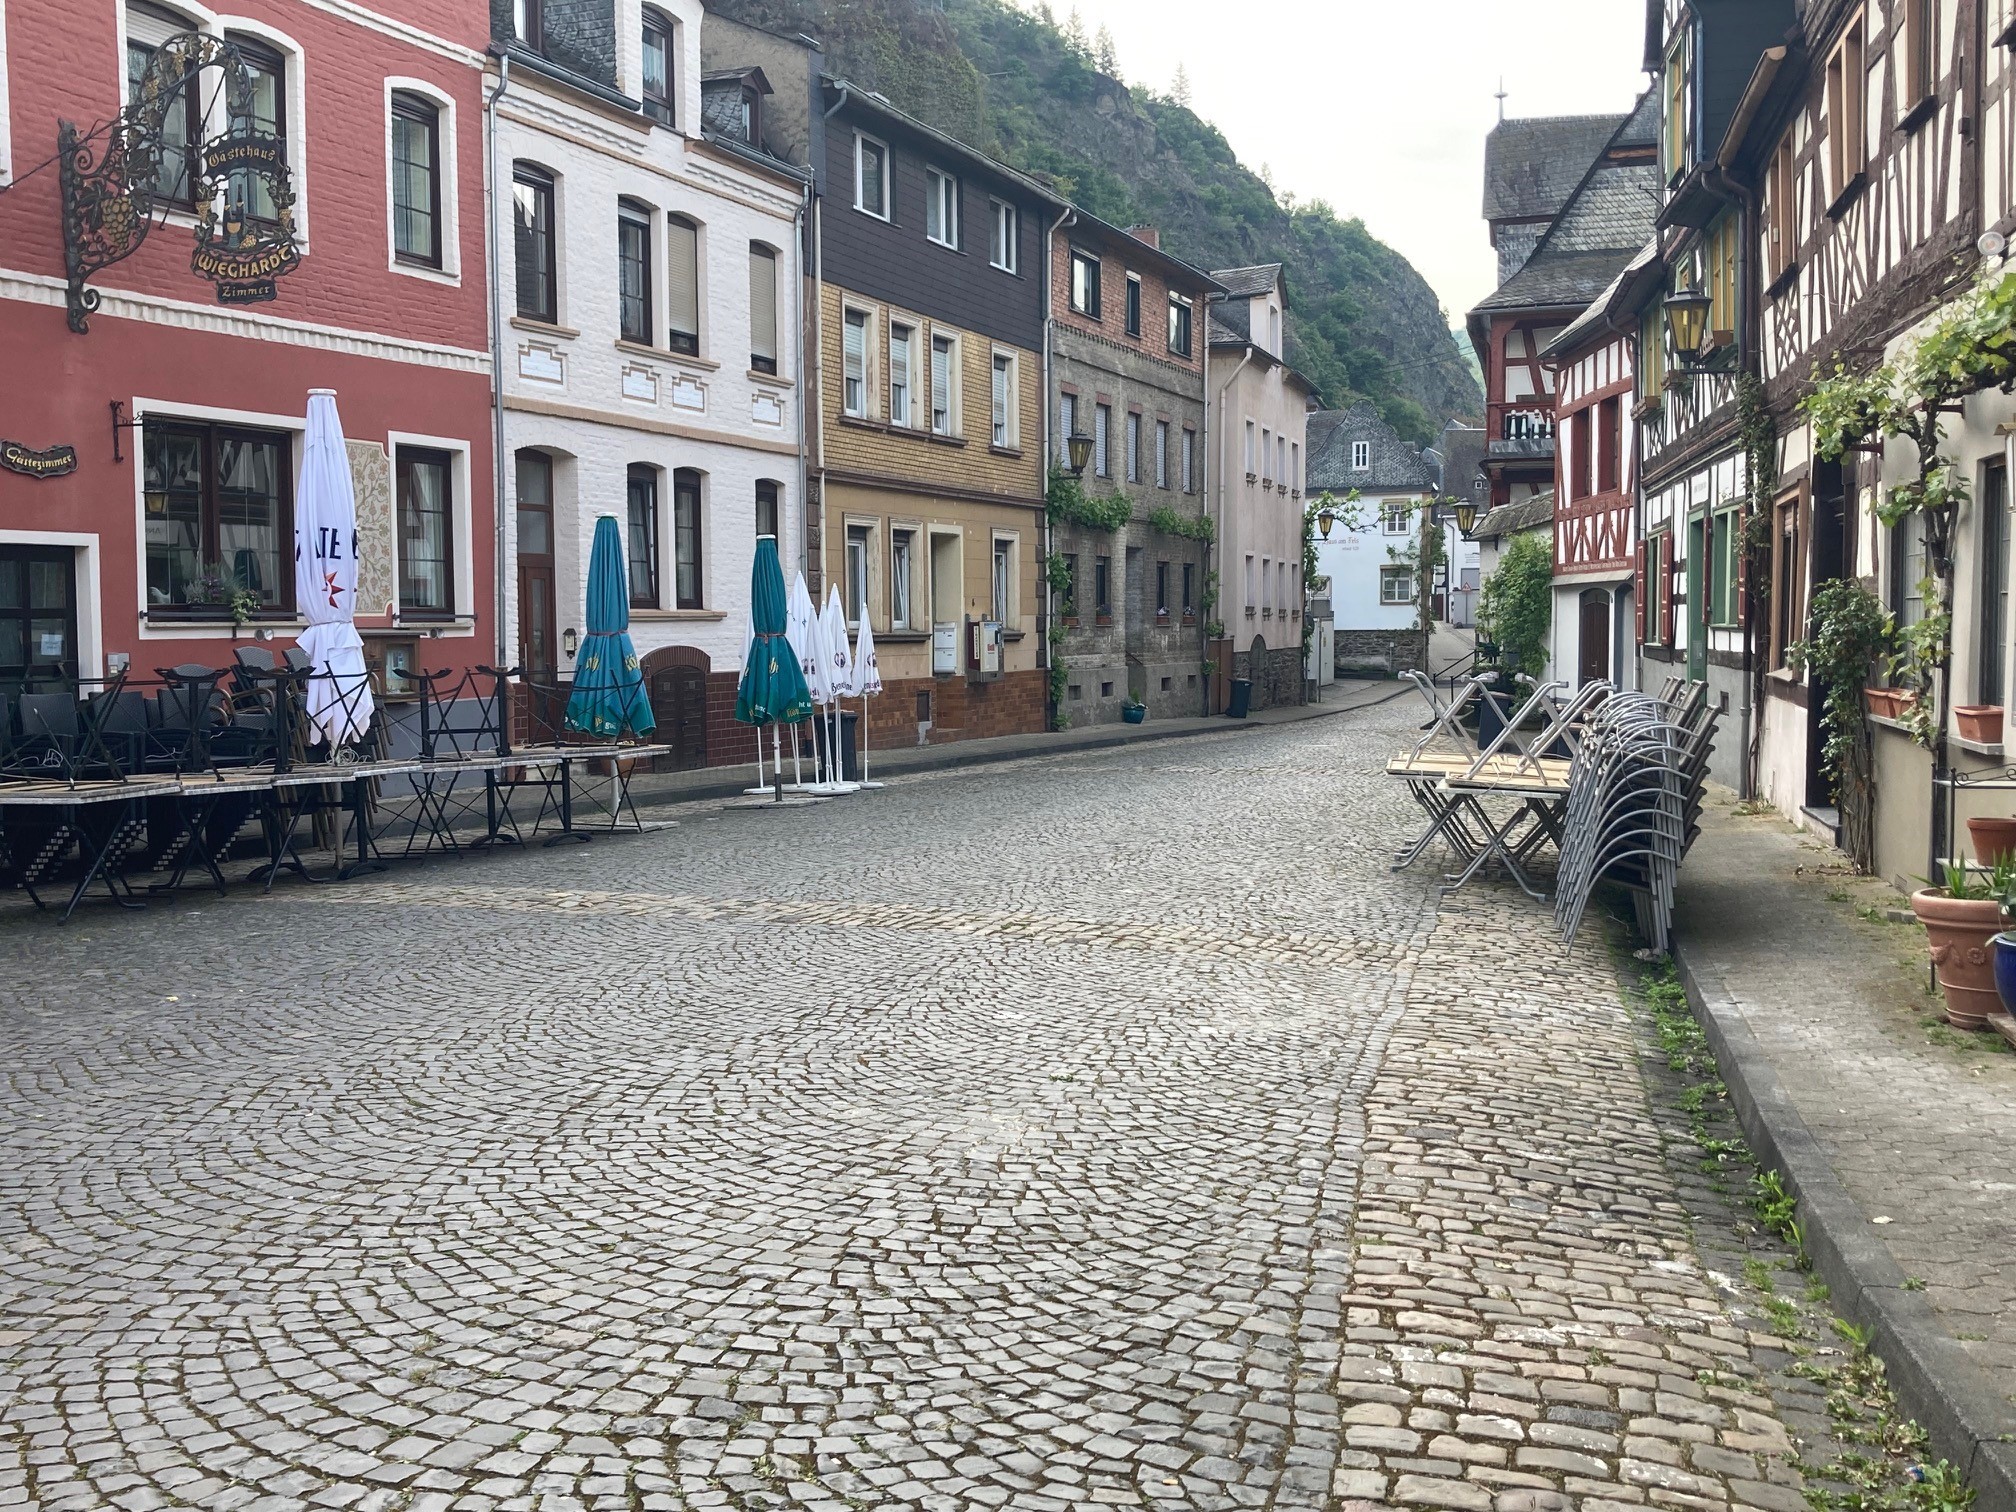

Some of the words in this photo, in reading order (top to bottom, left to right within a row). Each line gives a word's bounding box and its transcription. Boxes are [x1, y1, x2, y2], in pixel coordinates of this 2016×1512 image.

[208, 145, 276, 168] Gästehaus
[222, 284, 271, 298] Zimmer
[6, 447, 72, 471] Gästezimmer
